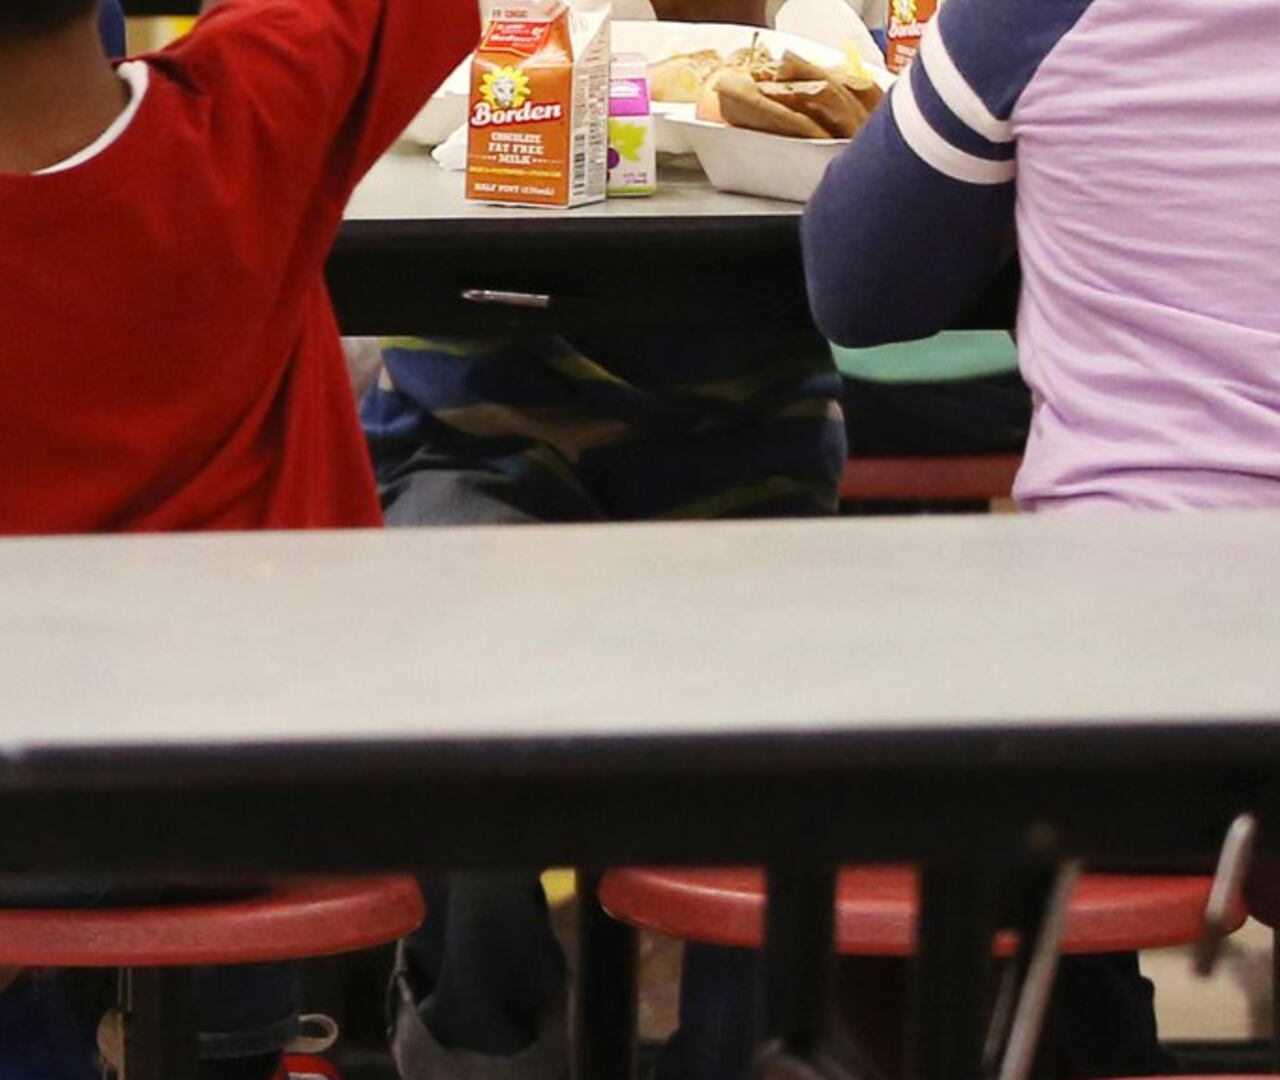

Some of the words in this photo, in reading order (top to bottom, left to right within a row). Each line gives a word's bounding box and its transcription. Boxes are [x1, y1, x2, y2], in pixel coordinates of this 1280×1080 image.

[471, 102, 561, 126] Borden
[491, 131, 542, 144] CHOCOLATE
[487, 142, 510, 153] FAT
[512, 144, 544, 155] FREE
[497, 153, 531, 165] MILK
